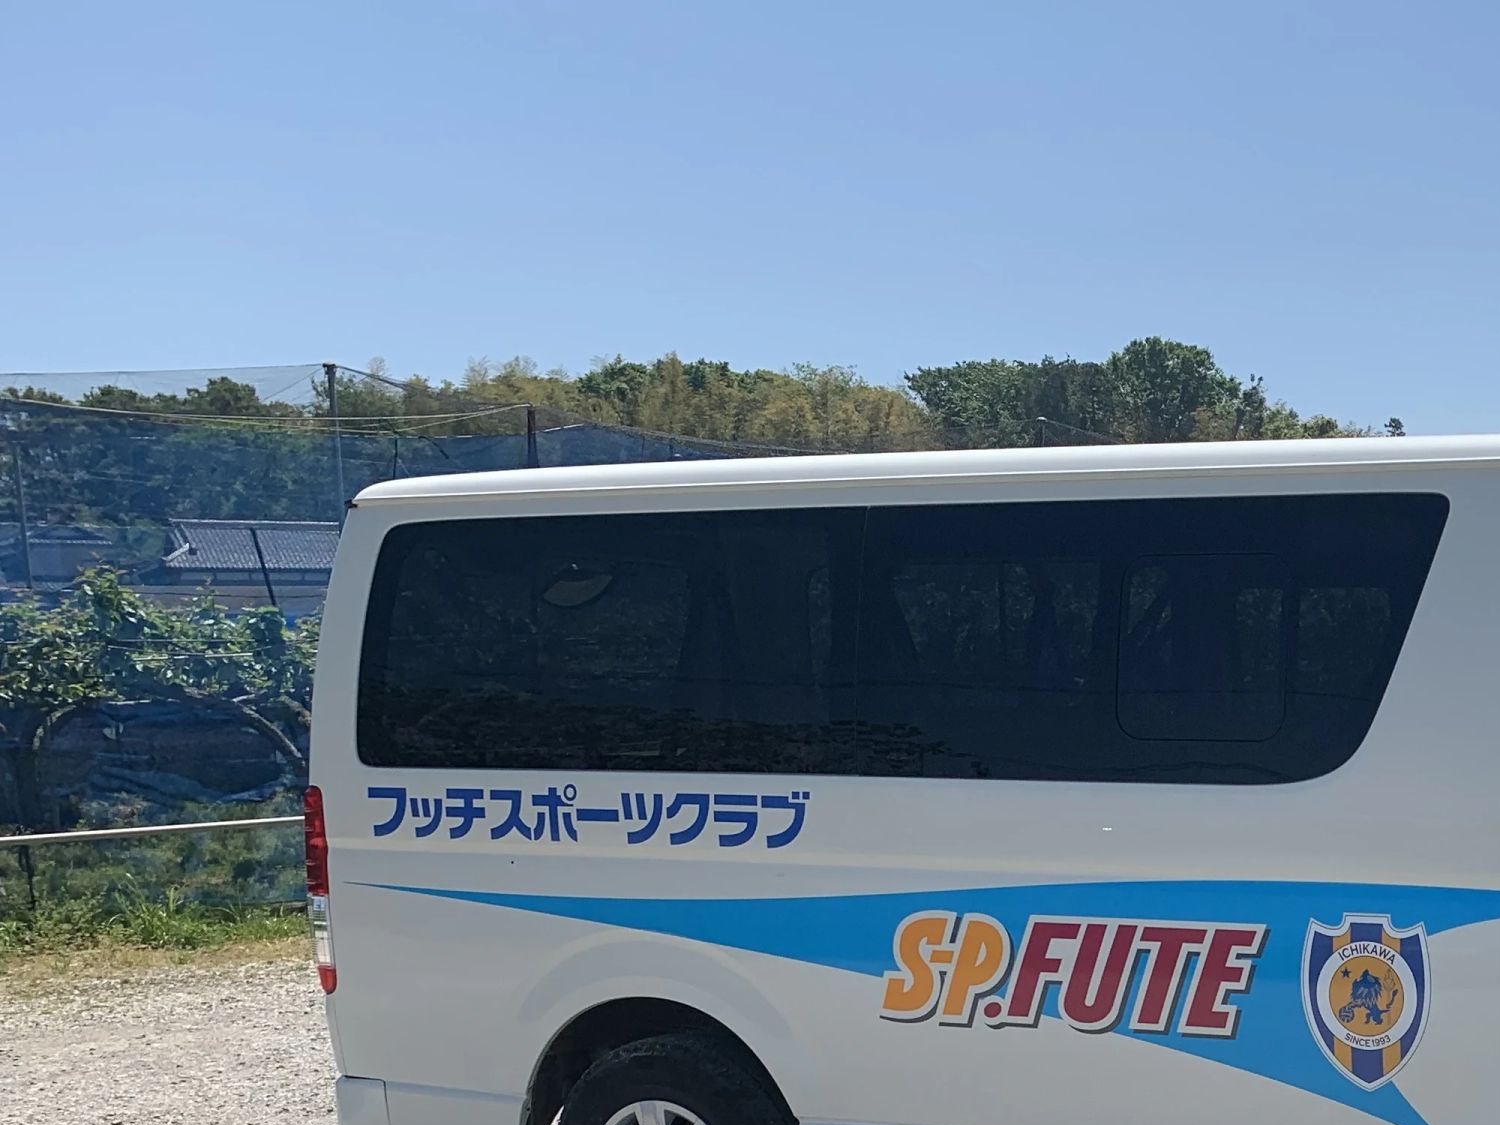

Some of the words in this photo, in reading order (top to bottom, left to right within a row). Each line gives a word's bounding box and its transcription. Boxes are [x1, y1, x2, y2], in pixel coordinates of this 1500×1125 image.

[367, 783, 810, 849] フッチスポーツクラブ
[1339, 943, 1396, 965] ICHIKAWA
